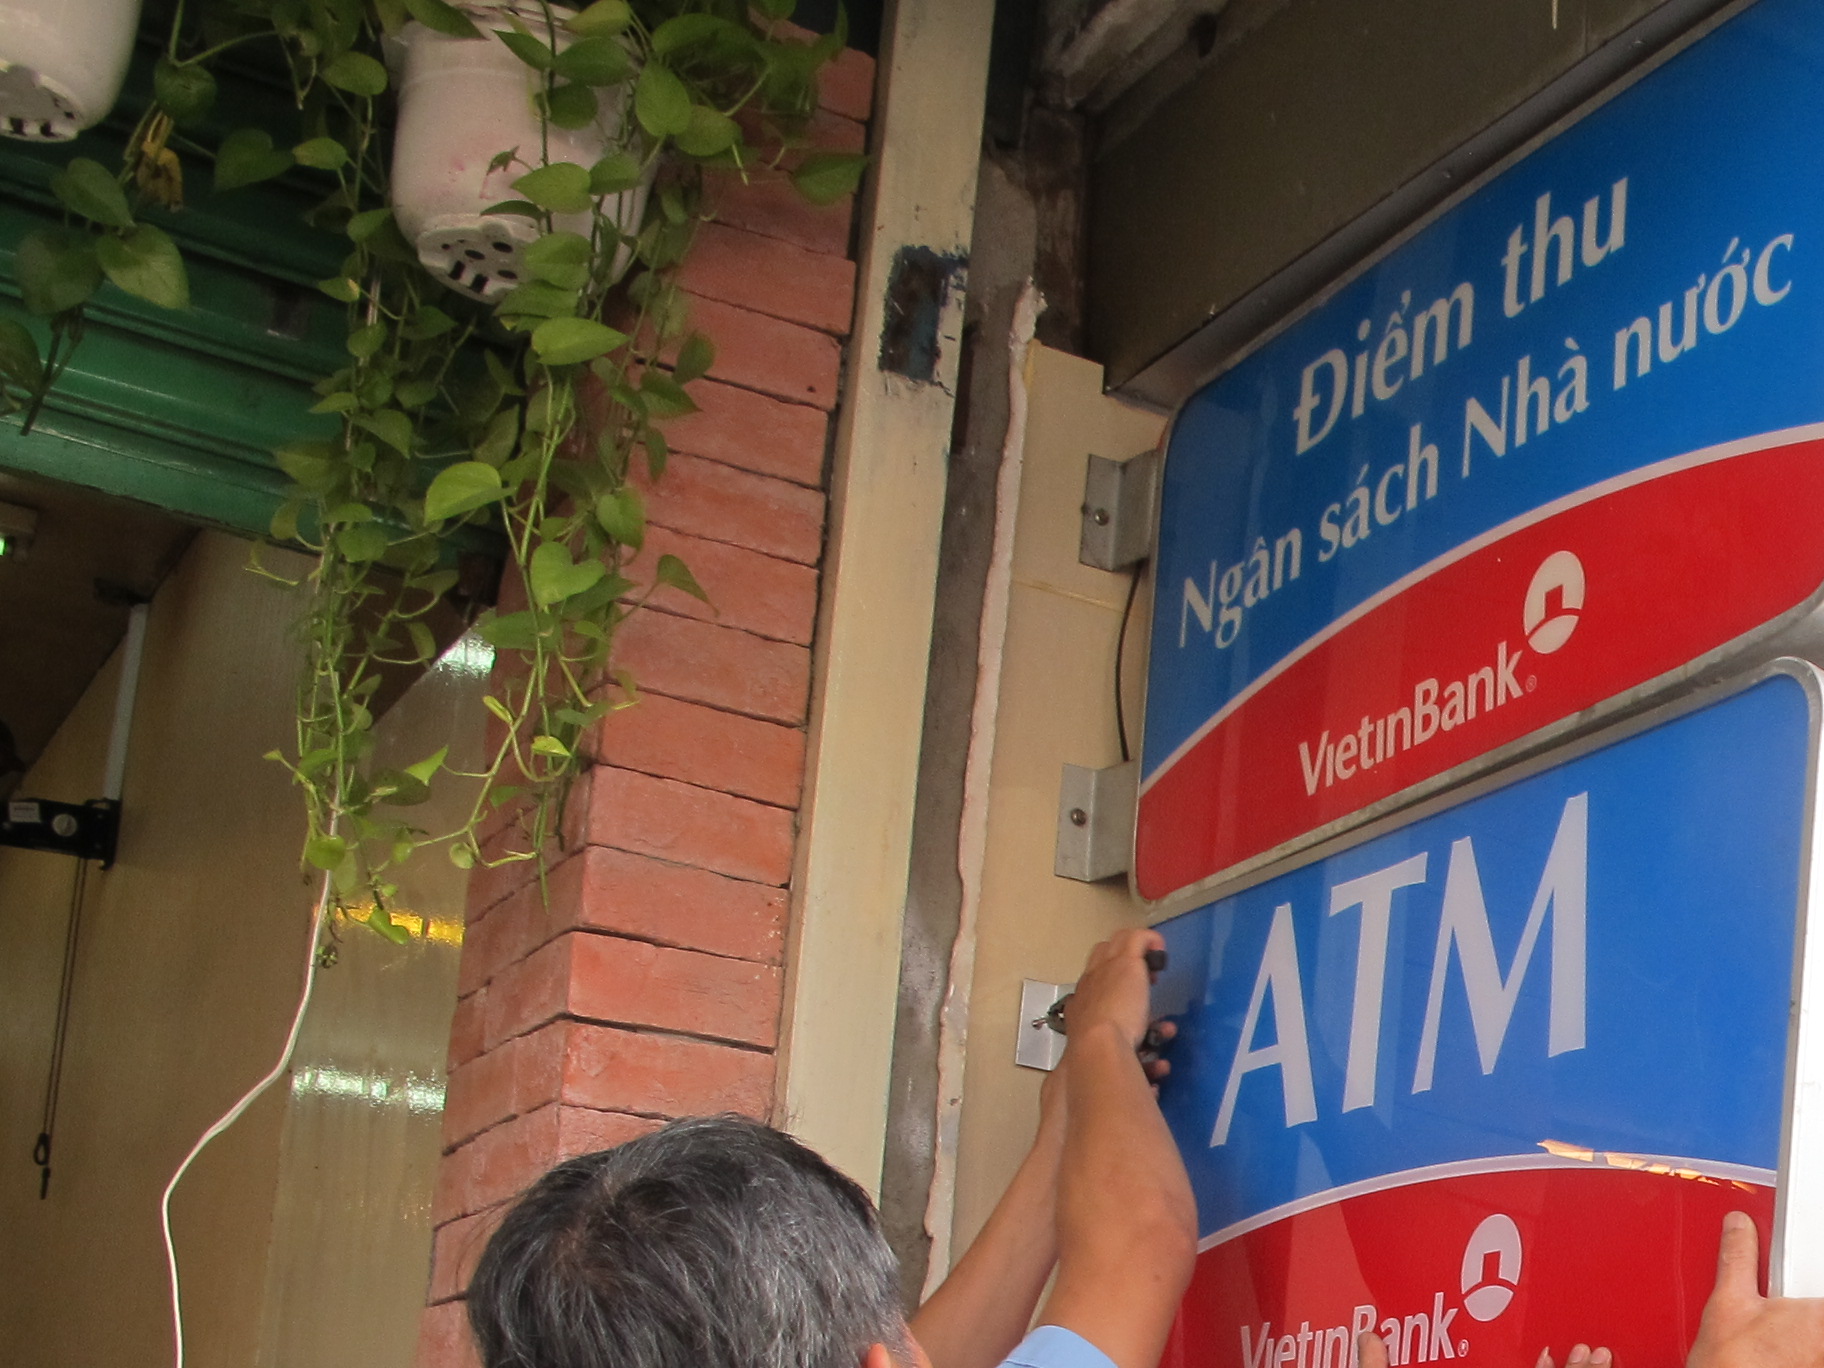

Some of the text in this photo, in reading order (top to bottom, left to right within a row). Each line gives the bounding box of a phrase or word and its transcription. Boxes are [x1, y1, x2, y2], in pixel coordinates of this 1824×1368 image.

[1179, 234, 1794, 650] Ngân sách Nhà nước
[1295, 177, 1629, 456] Điểm thu
[1298, 640, 1525, 796] VietinBank
[1209, 791, 1590, 1149] ATM
